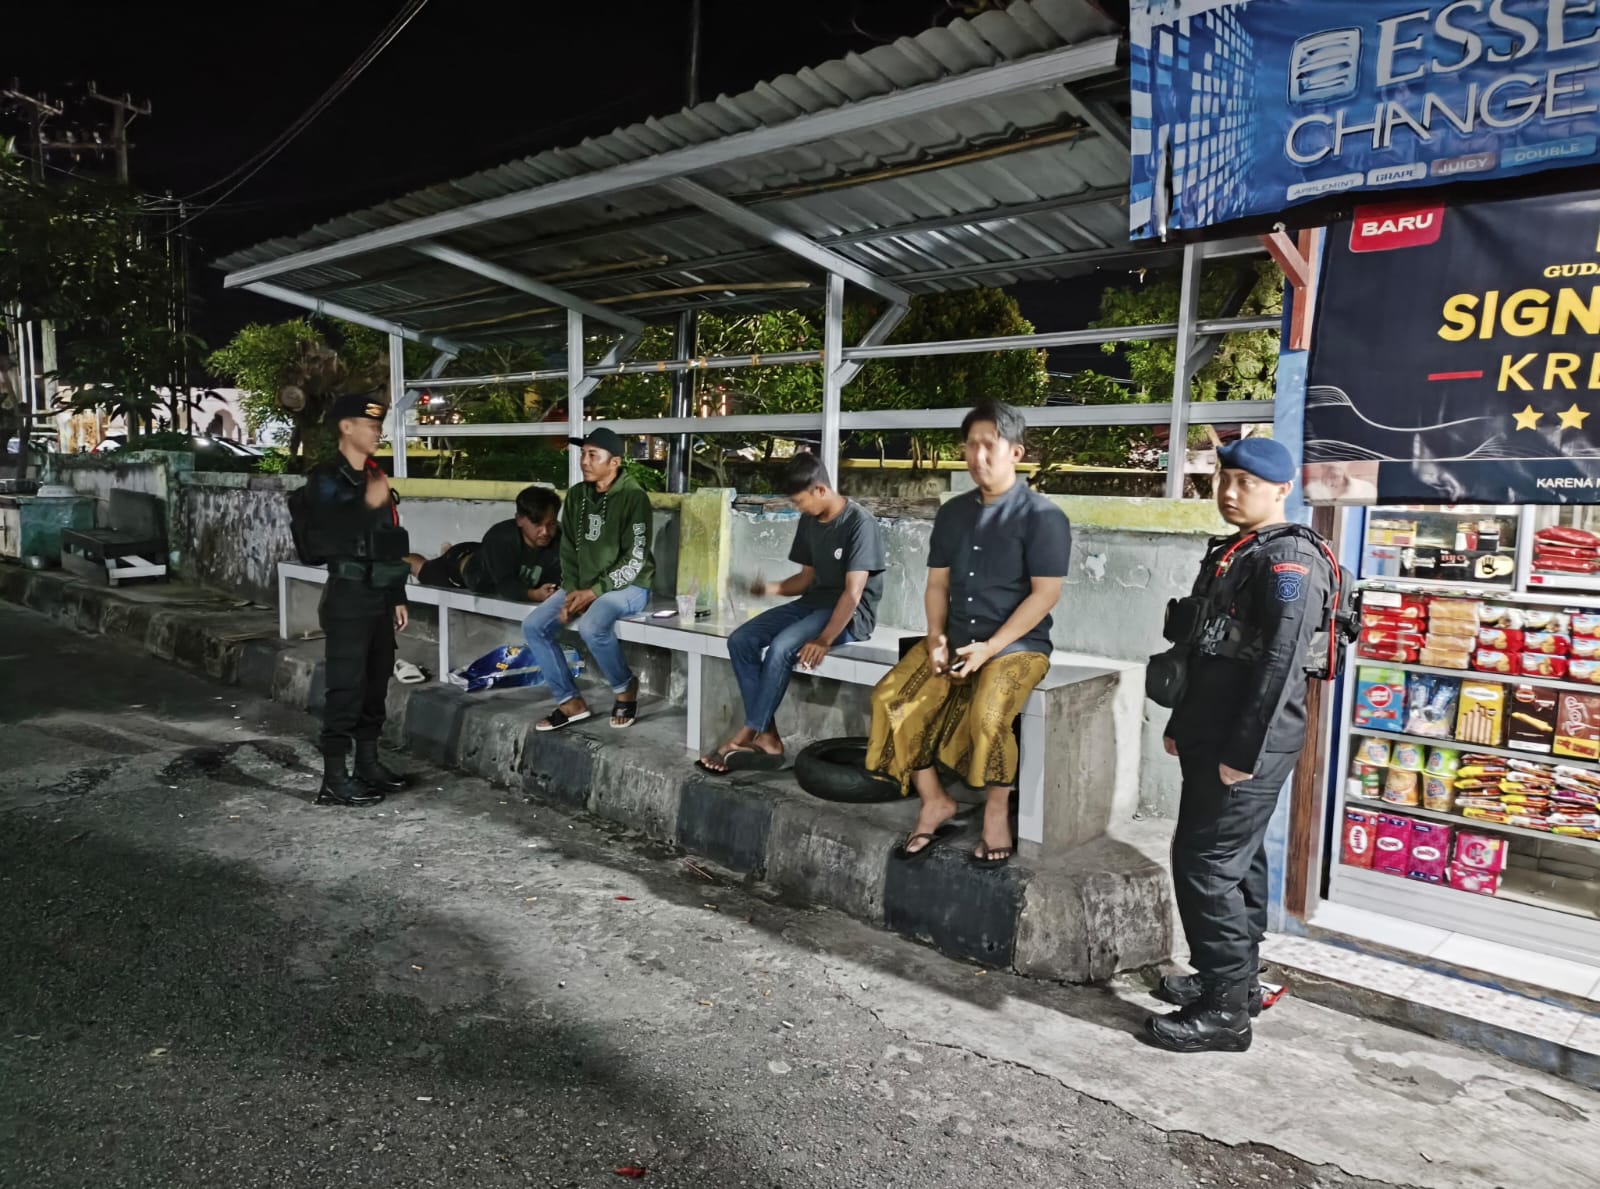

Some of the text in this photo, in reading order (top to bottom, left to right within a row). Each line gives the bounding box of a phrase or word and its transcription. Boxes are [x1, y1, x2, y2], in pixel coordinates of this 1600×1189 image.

[1285, 61, 1600, 164] CHANGE
[1375, 168, 1418, 183] GRAPE
[1438, 157, 1489, 175] JUICY
[1514, 143, 1580, 162] DOUBLE
[1361, 212, 1433, 237] BARU
[1543, 262, 1600, 278] GUD
[1536, 477, 1594, 489] KARENA
